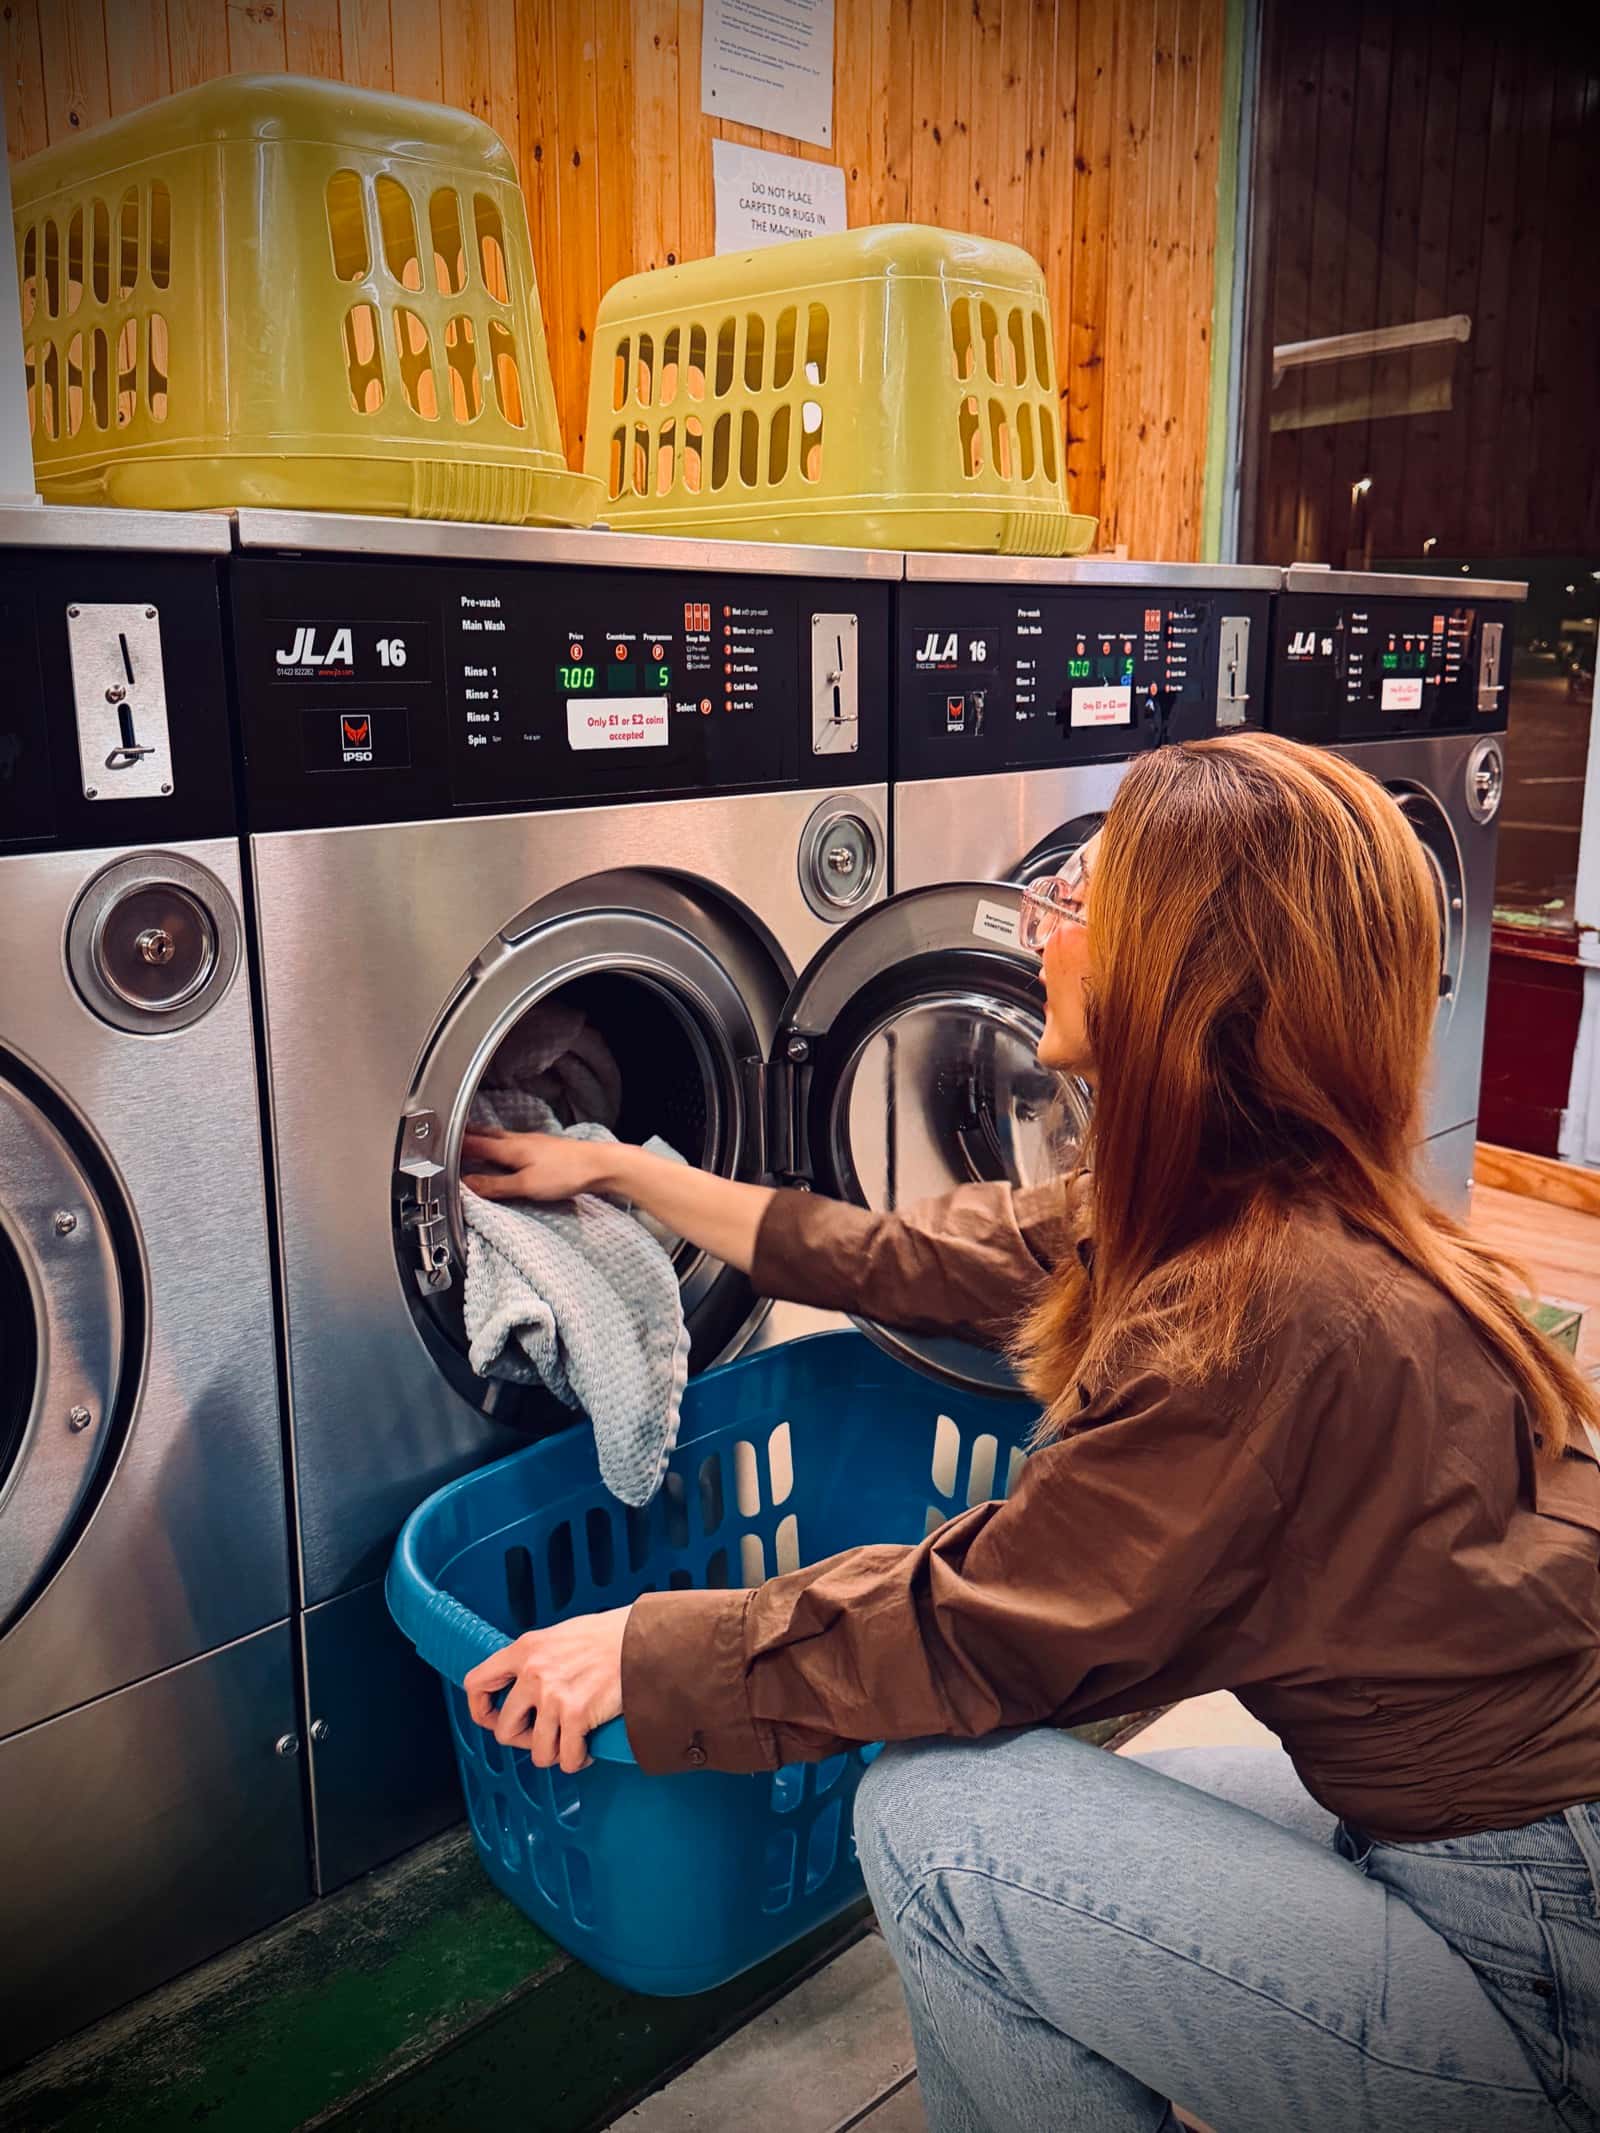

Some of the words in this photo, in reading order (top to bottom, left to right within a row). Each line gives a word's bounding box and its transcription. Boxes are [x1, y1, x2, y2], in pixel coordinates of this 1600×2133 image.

[752, 182, 765, 194] DO
[768, 186, 785, 199] NOT
[788, 190, 813, 205] PLACE
[739, 198, 776, 216] CARPETS
[779, 206, 791, 219] OR
[793, 209, 815, 223] RUGS
[817, 214, 826, 225] IN
[752, 219, 767, 232] THE
[461, 596, 501, 608] Pre-wash
[462, 619, 483, 631] Main
[484, 619, 506, 631] Wash
[276, 627, 353, 665] JLA
[376, 638, 407, 667] 16
[916, 633, 959, 661] JLA
[969, 640, 987, 662] 16
[1287, 632, 1315, 655] JLA
[1321, 638, 1333, 655] 16
[464, 665, 488, 677] Rinse
[491, 666, 497, 677] 1
[1126, 659, 1134, 674] 5
[659, 667, 669, 687] 5
[465, 688, 489, 700] Rinse
[492, 688, 499, 699] 2
[676, 703, 697, 713] Select
[467, 711, 490, 722] Rinse
[493, 711, 500, 721] 3
[587, 716, 607, 728] Only
[609, 714, 619, 726] £1
[621, 718, 630, 726] or
[632, 713, 644, 725] £2
[645, 715, 664, 725] coins
[468, 733, 487, 747] Spin
[609, 730, 645, 742] accepted
[343, 751, 373, 762] IPSO
